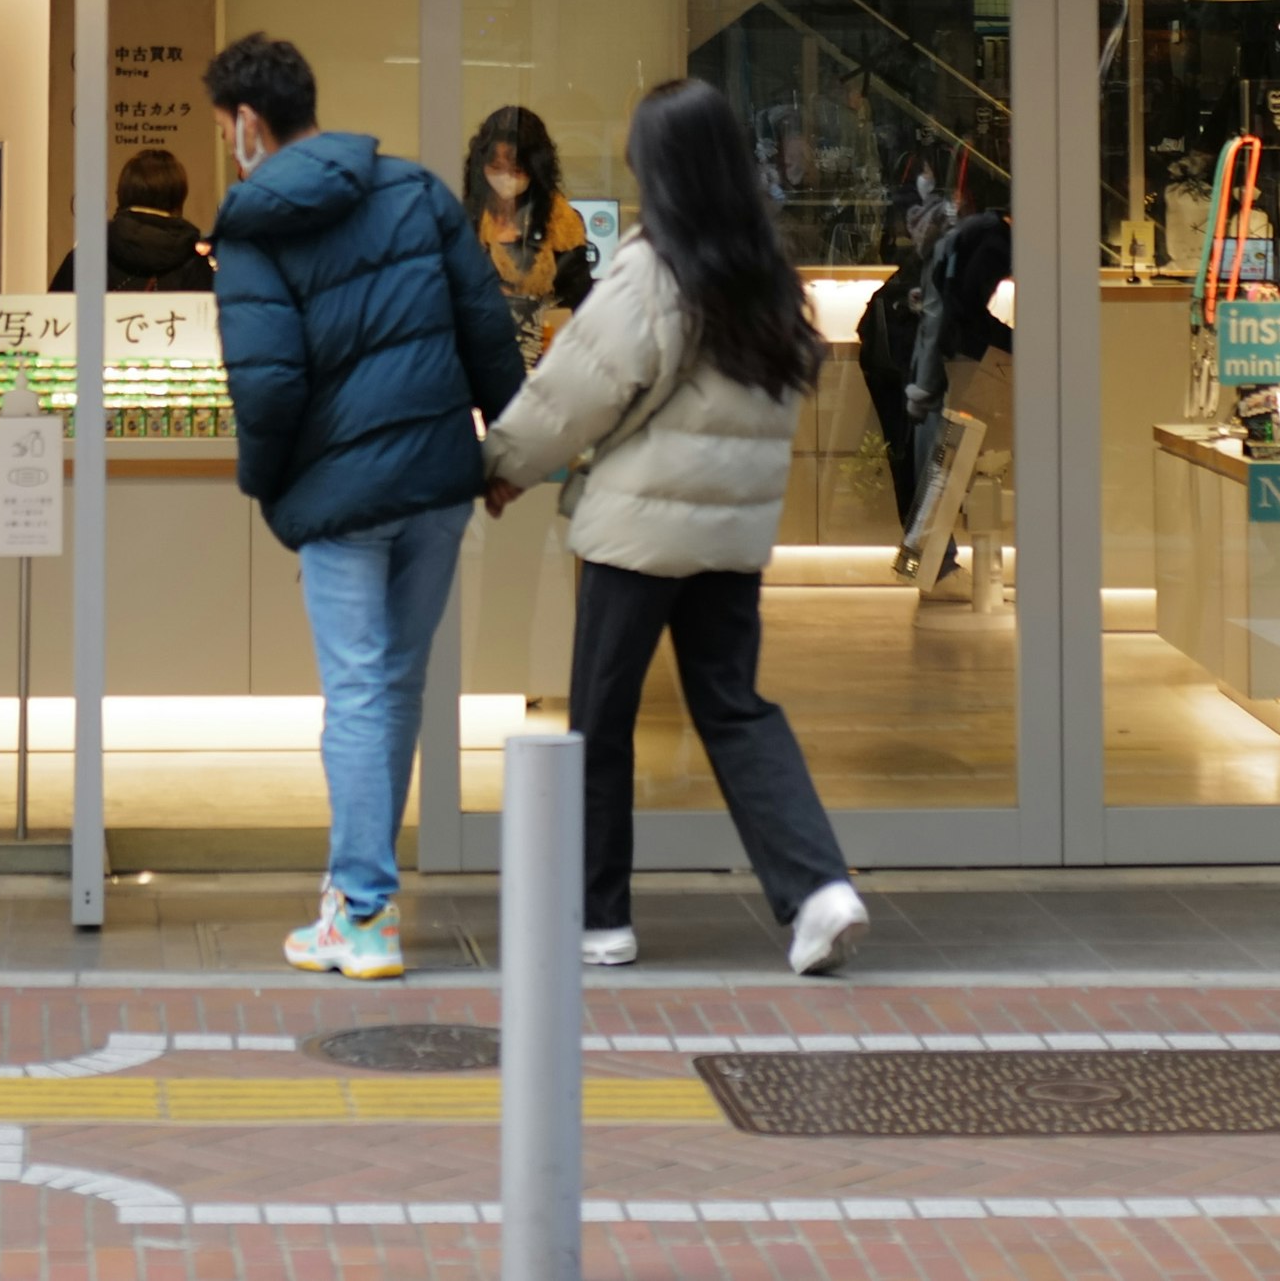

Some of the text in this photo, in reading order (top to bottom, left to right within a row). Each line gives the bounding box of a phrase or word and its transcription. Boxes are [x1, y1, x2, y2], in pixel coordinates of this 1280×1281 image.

[115, 46, 183, 62] 中古買取
[115, 67, 149, 78] Buying
[115, 101, 191, 117] 中古カメラ
[115, 122, 178, 132] Used Camera
[115, 135, 165, 144] Used Lens
